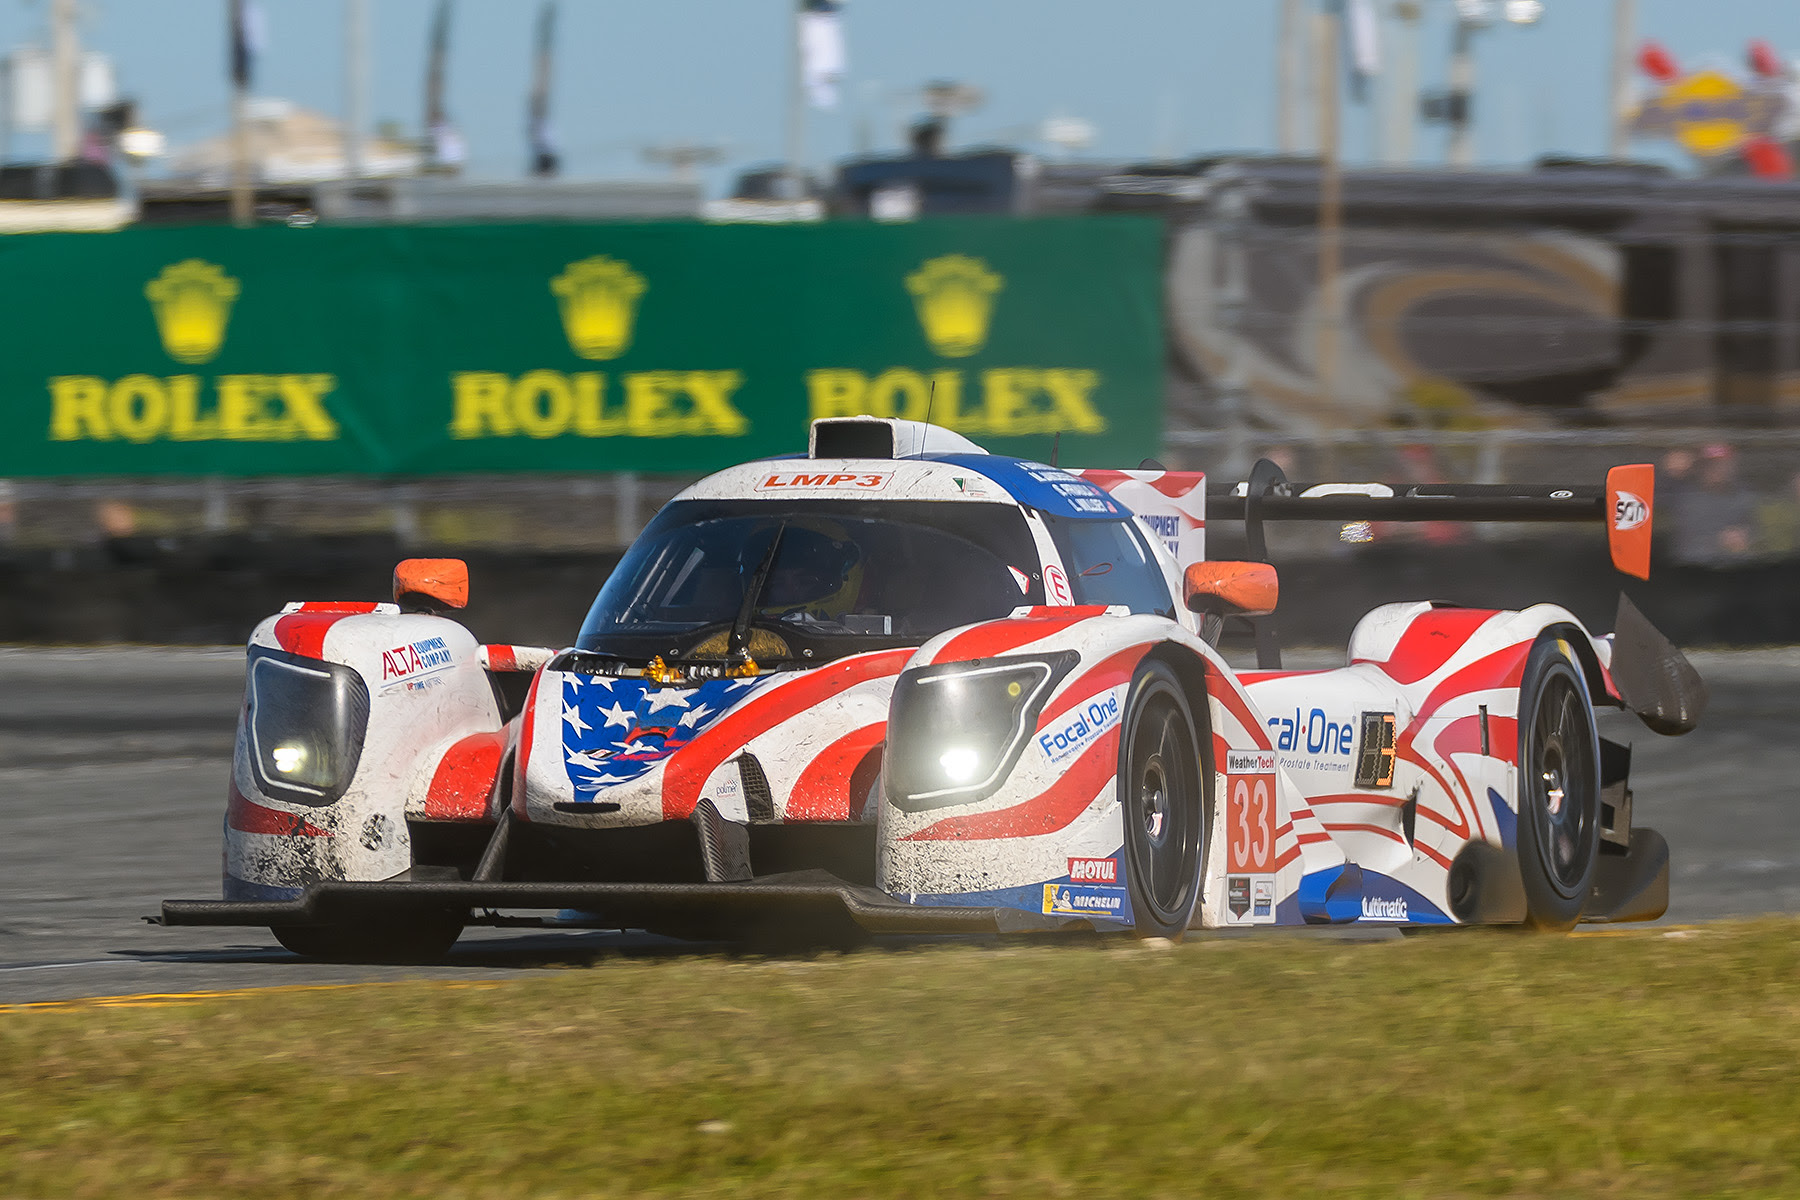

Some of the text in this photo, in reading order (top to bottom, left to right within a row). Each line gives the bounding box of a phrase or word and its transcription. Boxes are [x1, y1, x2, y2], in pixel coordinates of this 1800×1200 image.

[48, 372, 337, 442] ROLEX
[449, 369, 749, 438] ROLEX
[764, 474, 884, 488] LMP3
[413, 636, 448, 654] EQUIPMENT
[382, 644, 424, 680] ALTA
[421, 649, 454, 668] COMPANY
[1228, 755, 1275, 770] WeatherTech
[1280, 757, 1350, 773] Prostate Treatment
[1233, 779, 1270, 868] 33
[1071, 860, 1115, 880] MOTUL
[1072, 895, 1121, 909] MICHELIN
